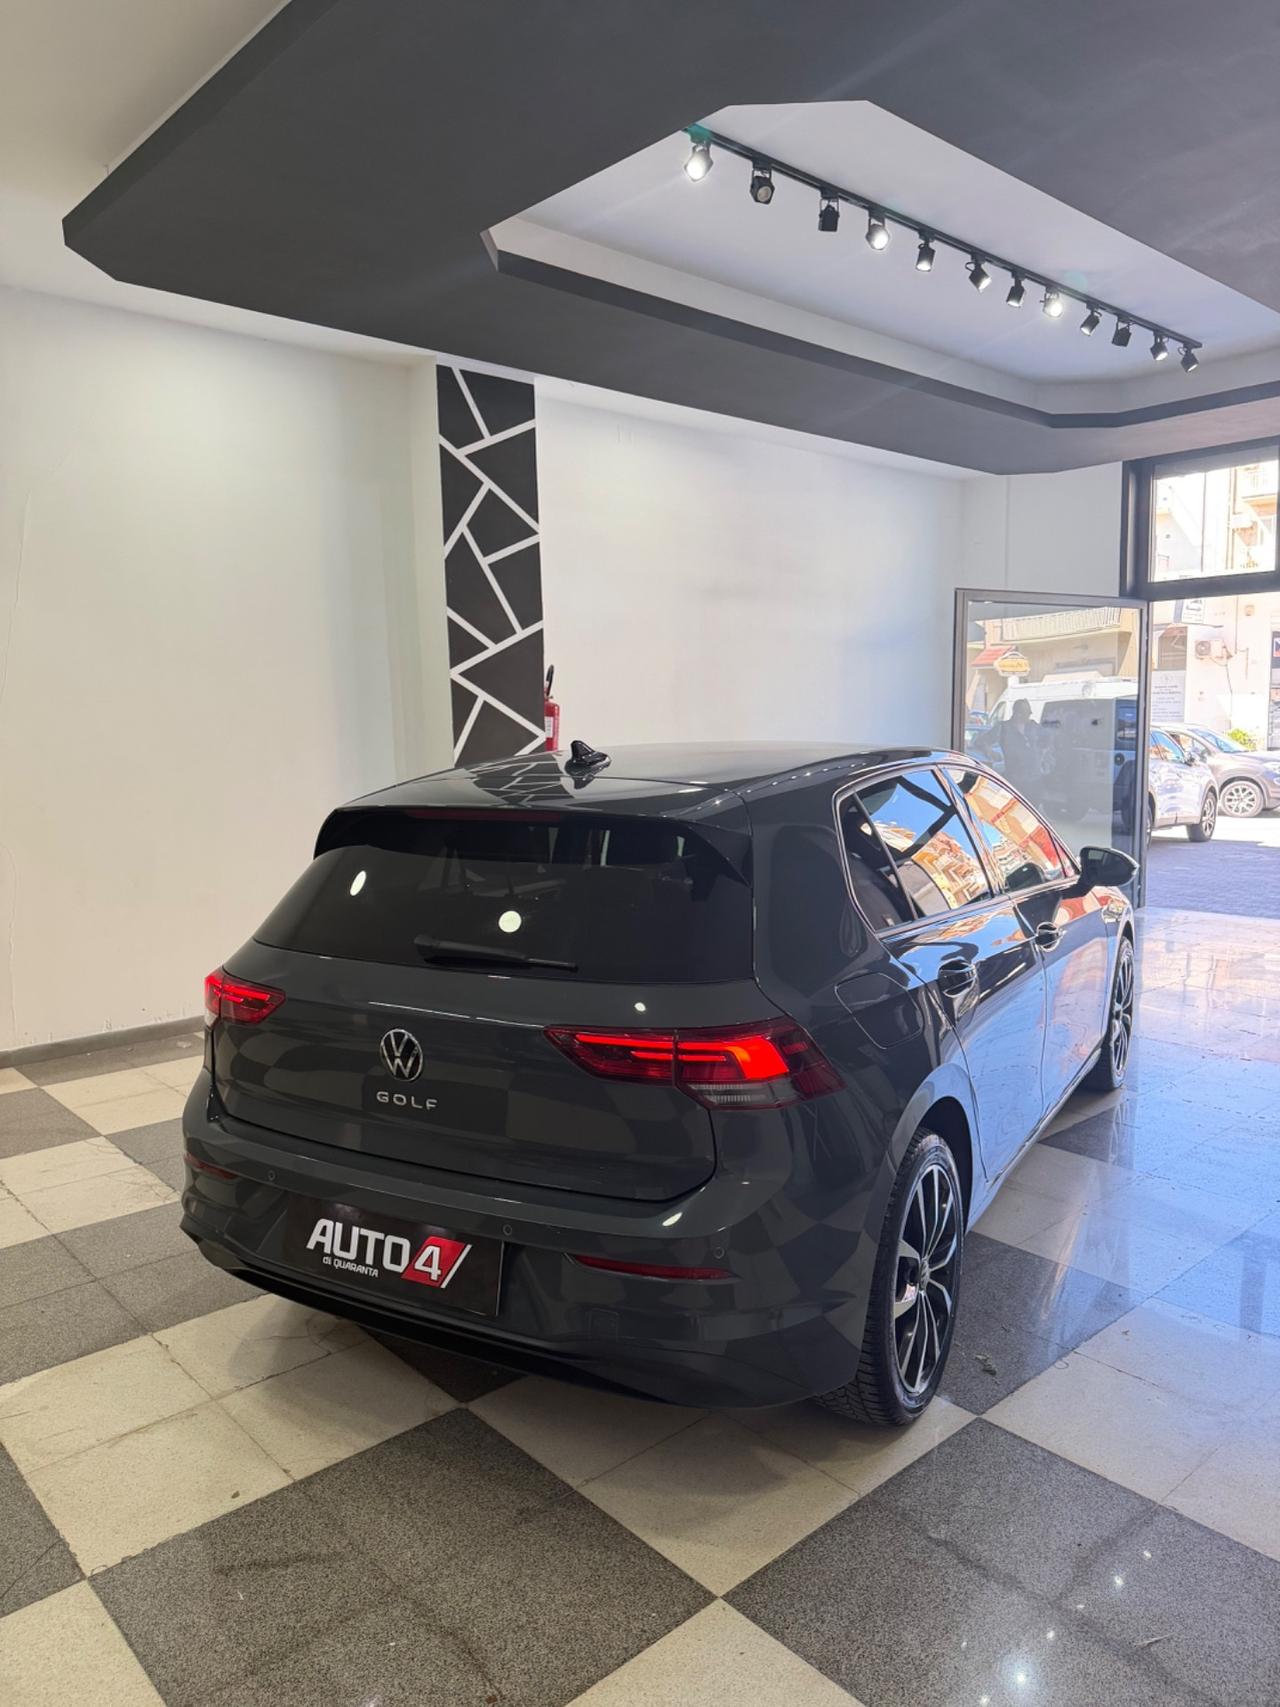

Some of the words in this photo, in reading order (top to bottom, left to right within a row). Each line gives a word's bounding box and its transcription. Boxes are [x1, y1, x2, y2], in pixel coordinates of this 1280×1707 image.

[376, 1091, 438, 1110] GOLF
[322, 1255, 332, 1266] di
[333, 1258, 379, 1278] QUARANTA
